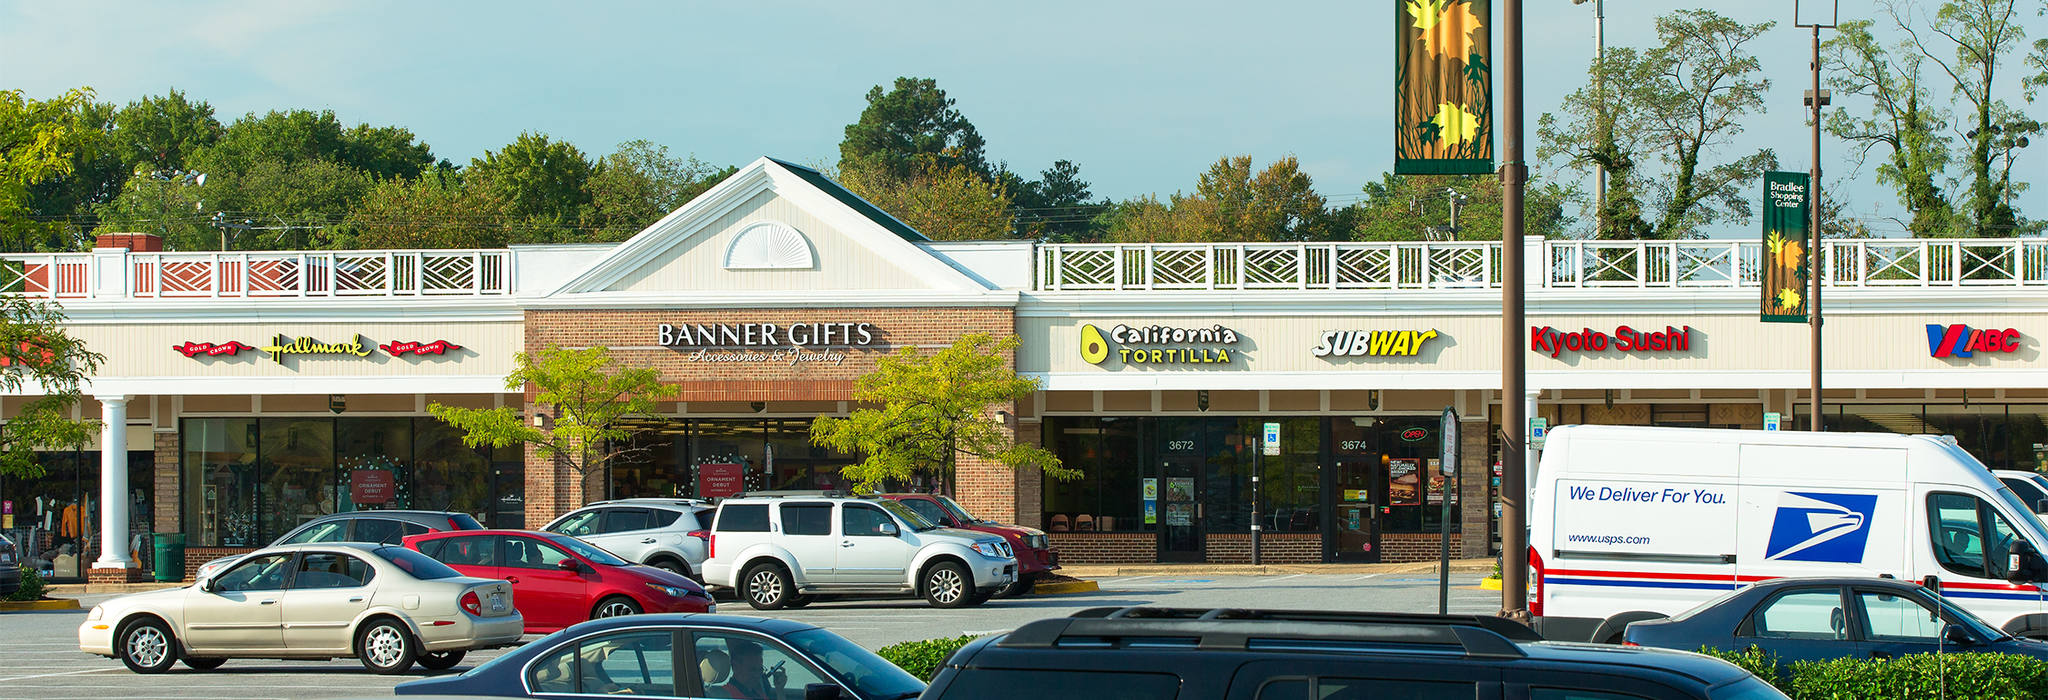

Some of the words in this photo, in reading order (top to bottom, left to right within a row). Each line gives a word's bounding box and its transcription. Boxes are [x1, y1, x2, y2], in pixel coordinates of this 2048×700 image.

[1770, 181, 1804, 192] Bradlee
[1770, 191, 1804, 202] Shopping
[1775, 200, 1799, 208] Center
[658, 323, 779, 345] BANNER
[788, 323, 872, 345] GIFTS
[1111, 324, 1237, 345] California
[1311, 328, 1438, 357] SUBWAY
[1531, 325, 1608, 358] Kyoto
[1615, 325, 1689, 351] Sushi
[1964, 328, 2021, 353] ABC
[210, 346, 232, 354] CROWN
[260, 333, 374, 365] Hallmark
[417, 345, 439, 353] CROWN
[689, 348, 767, 362] Accessories
[772, 350, 785, 362] &
[788, 348, 845, 366] Jewelry
[1119, 349, 1231, 363] TORTILLA
[1404, 430, 1425, 439] OPEN
[1169, 440, 1194, 450] 3672
[1341, 440, 1367, 450] 3674
[1570, 486, 1595, 500] We
[1599, 487, 1658, 502] Deliver
[1661, 488, 1690, 503] For
[1693, 489, 1726, 504] You.
[1568, 534, 1650, 545] www.usps.com
